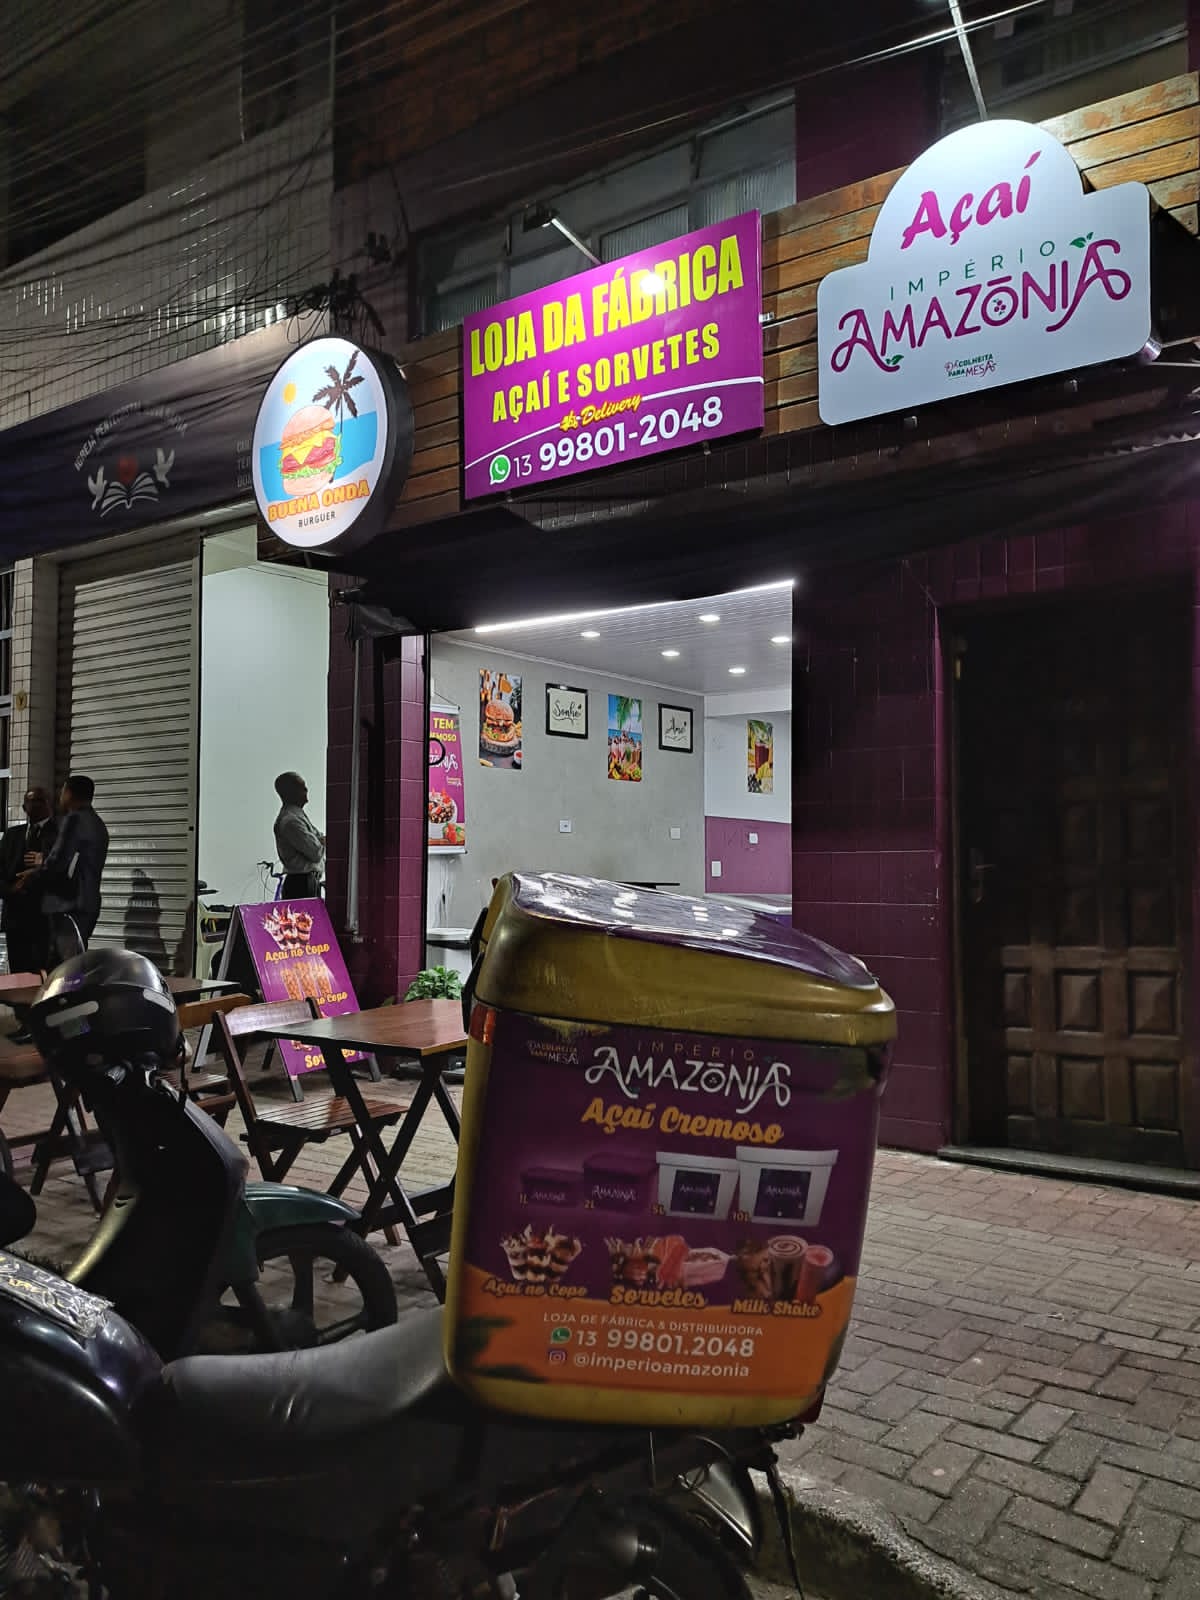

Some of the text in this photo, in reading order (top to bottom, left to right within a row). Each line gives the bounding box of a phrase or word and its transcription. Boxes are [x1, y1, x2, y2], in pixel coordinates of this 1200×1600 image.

[900, 150, 1042, 250] Açaí
[890, 240, 1056, 300] IMPÉRIO
[471, 234, 744, 377] LOJA DA FÁBRICA
[492, 322, 720, 424] AÇAÍ E SORVETES
[581, 395, 642, 427] Delivery
[514, 396, 723, 478] 13 99801-2048
[268, 479, 370, 522] BUENA ONDA
[298, 511, 336, 528] BURGUER
[433, 718, 454, 729] TEM
[290, 948, 304, 958] no
[305, 943, 330, 956] Copo
[327, 991, 348, 1004] Copo
[581, 1097, 785, 1144] Açaí Cremoso
[525, 1285, 544, 1296] no
[549, 1284, 588, 1298] Copo
[611, 1284, 707, 1307] Sorvetes
[733, 1299, 820, 1317] Milk Shake
[543, 1312, 763, 1337] LOJA DE FÁBRICA & DISTRIBUIDORA
[576, 1329, 754, 1357] 13 99801.2048
[573, 1351, 749, 1378] @imperioamazonia
